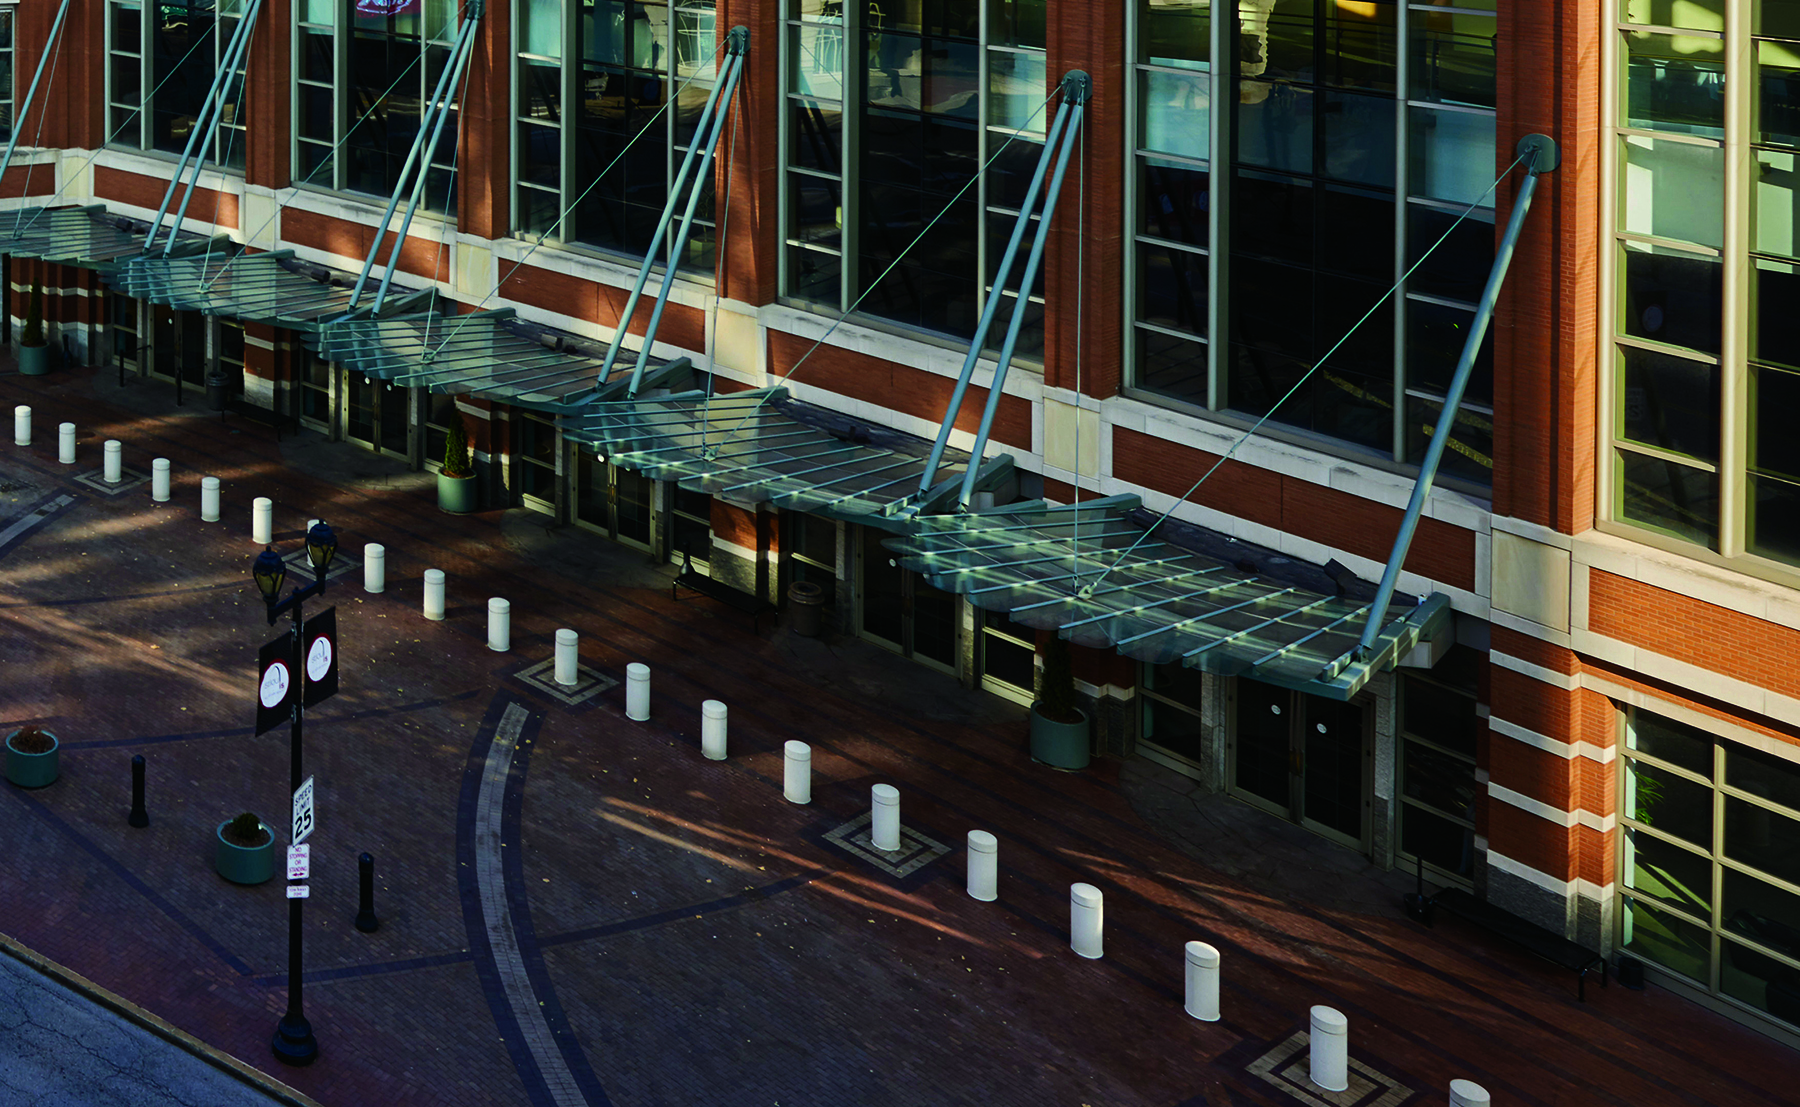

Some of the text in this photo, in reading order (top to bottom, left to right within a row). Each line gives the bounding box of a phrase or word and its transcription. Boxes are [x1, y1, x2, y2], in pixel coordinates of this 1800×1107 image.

[295, 784, 312, 806] SPEED
[296, 796, 310, 815] LIMIT
[294, 807, 312, 839] 25
